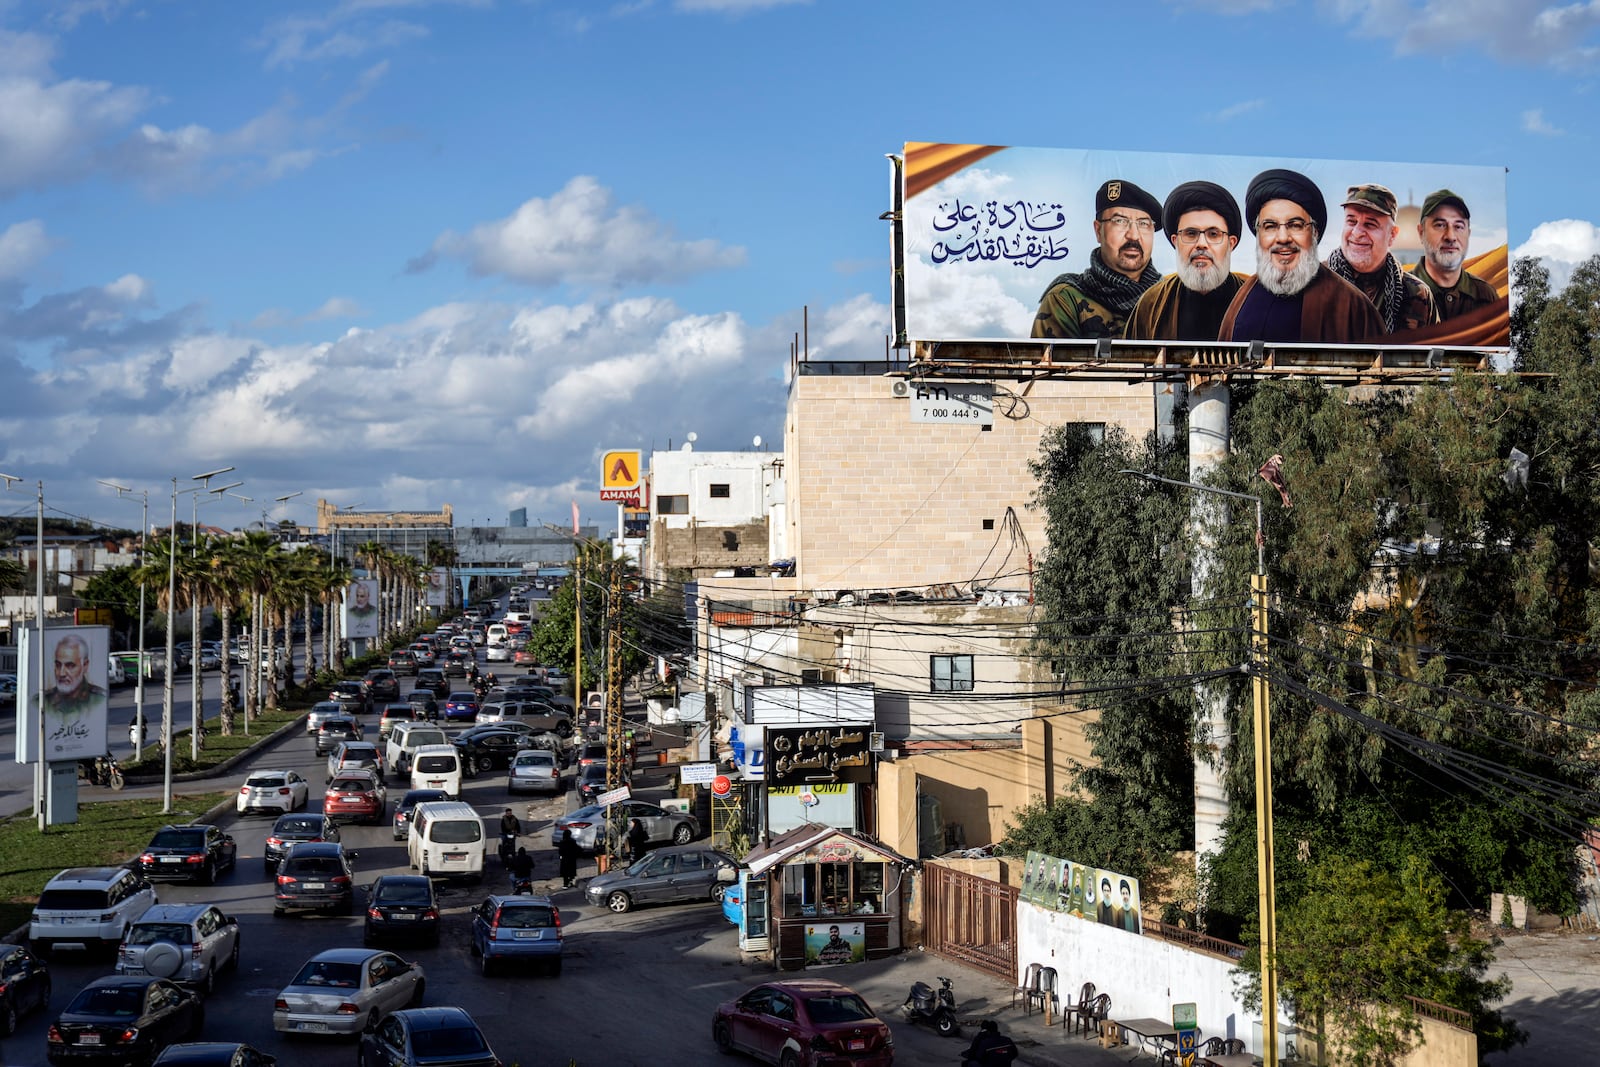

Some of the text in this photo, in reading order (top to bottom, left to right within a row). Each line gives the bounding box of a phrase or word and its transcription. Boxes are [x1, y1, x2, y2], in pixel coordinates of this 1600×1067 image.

[933, 198, 1066, 232] قادة على
[923, 408, 979, 419] 7 000 444 9
[601, 491, 641, 499] AMANA
[829, 728, 864, 749] مصلى
[775, 750, 870, 779] الحسن العسكري
